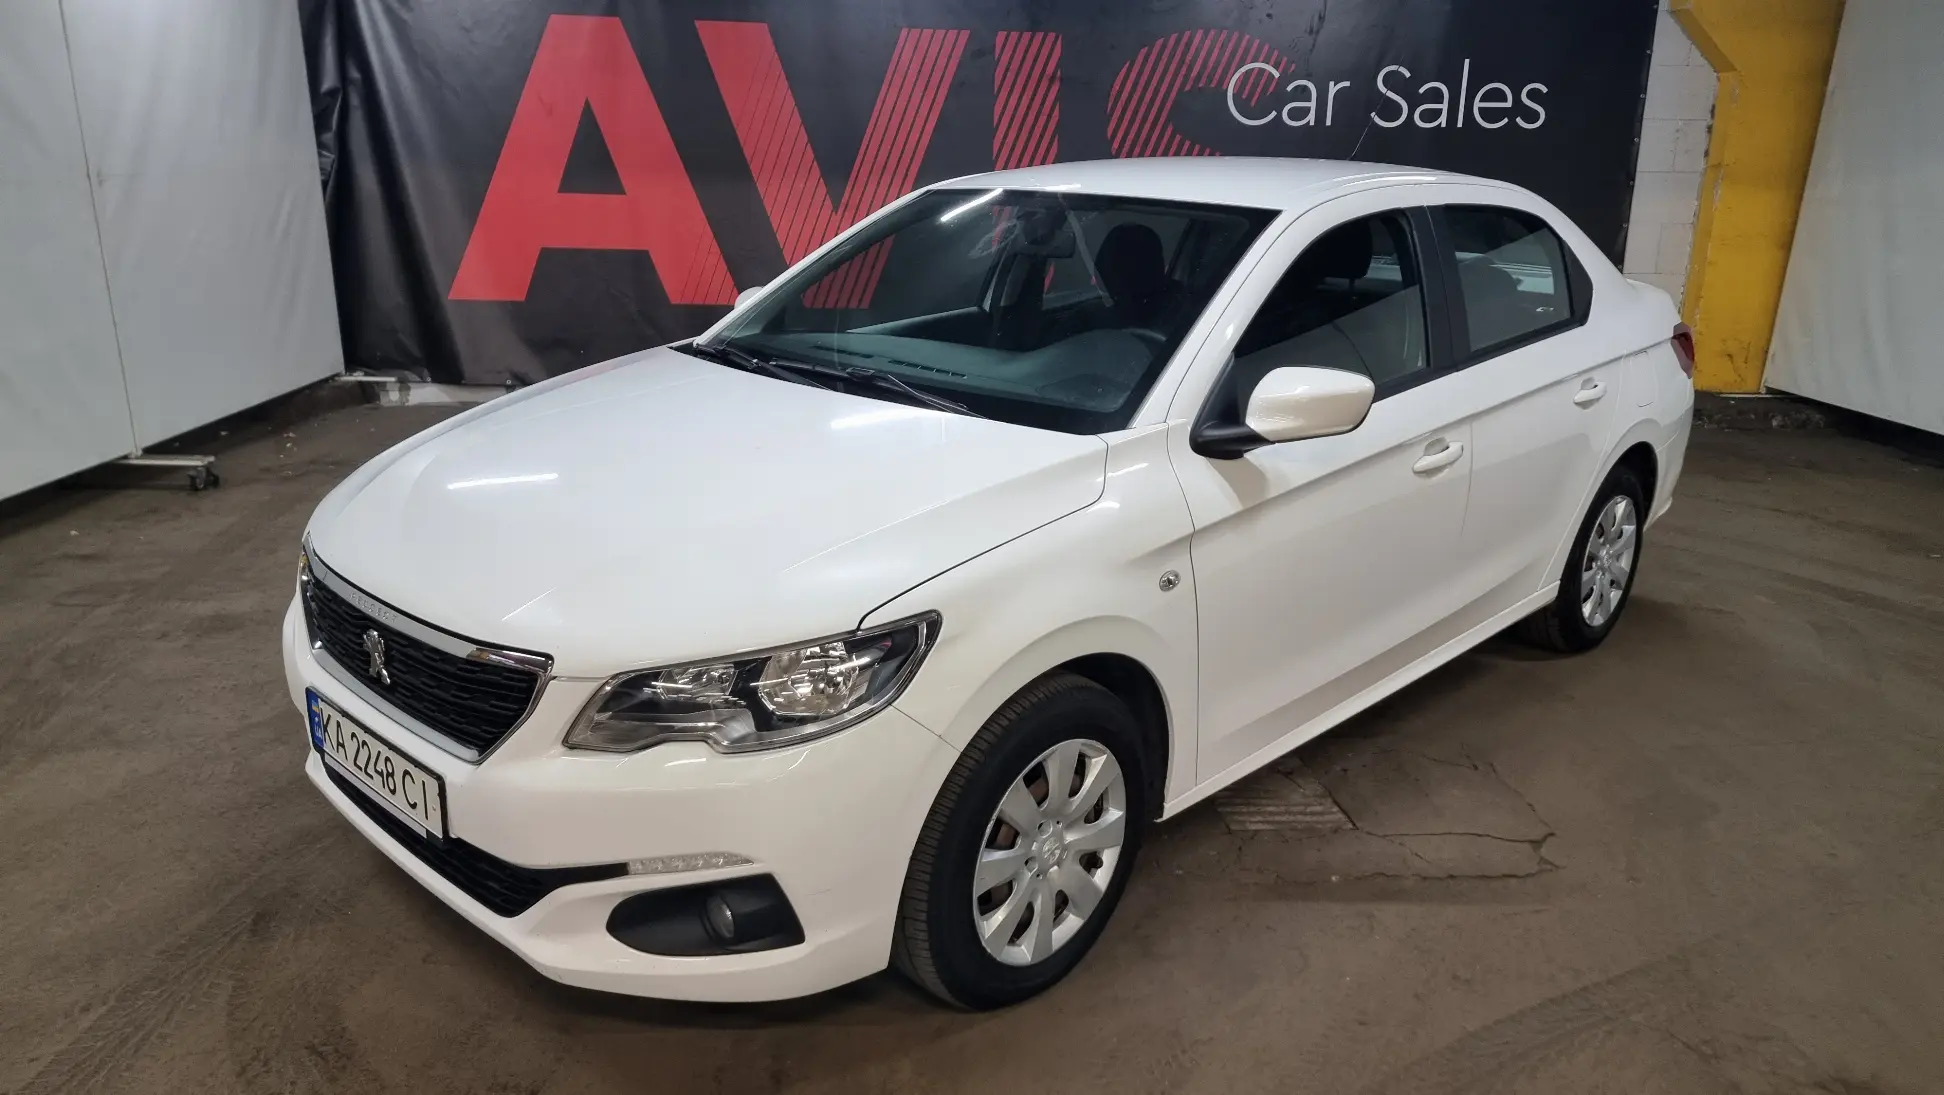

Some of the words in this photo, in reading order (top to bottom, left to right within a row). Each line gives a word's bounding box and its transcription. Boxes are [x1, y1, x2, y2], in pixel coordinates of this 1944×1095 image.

[1227, 61, 1350, 126] Car
[1371, 58, 1548, 130] Sales
[320, 707, 348, 761] KA
[351, 732, 397, 796] 2248
[402, 768, 429, 821] CI
